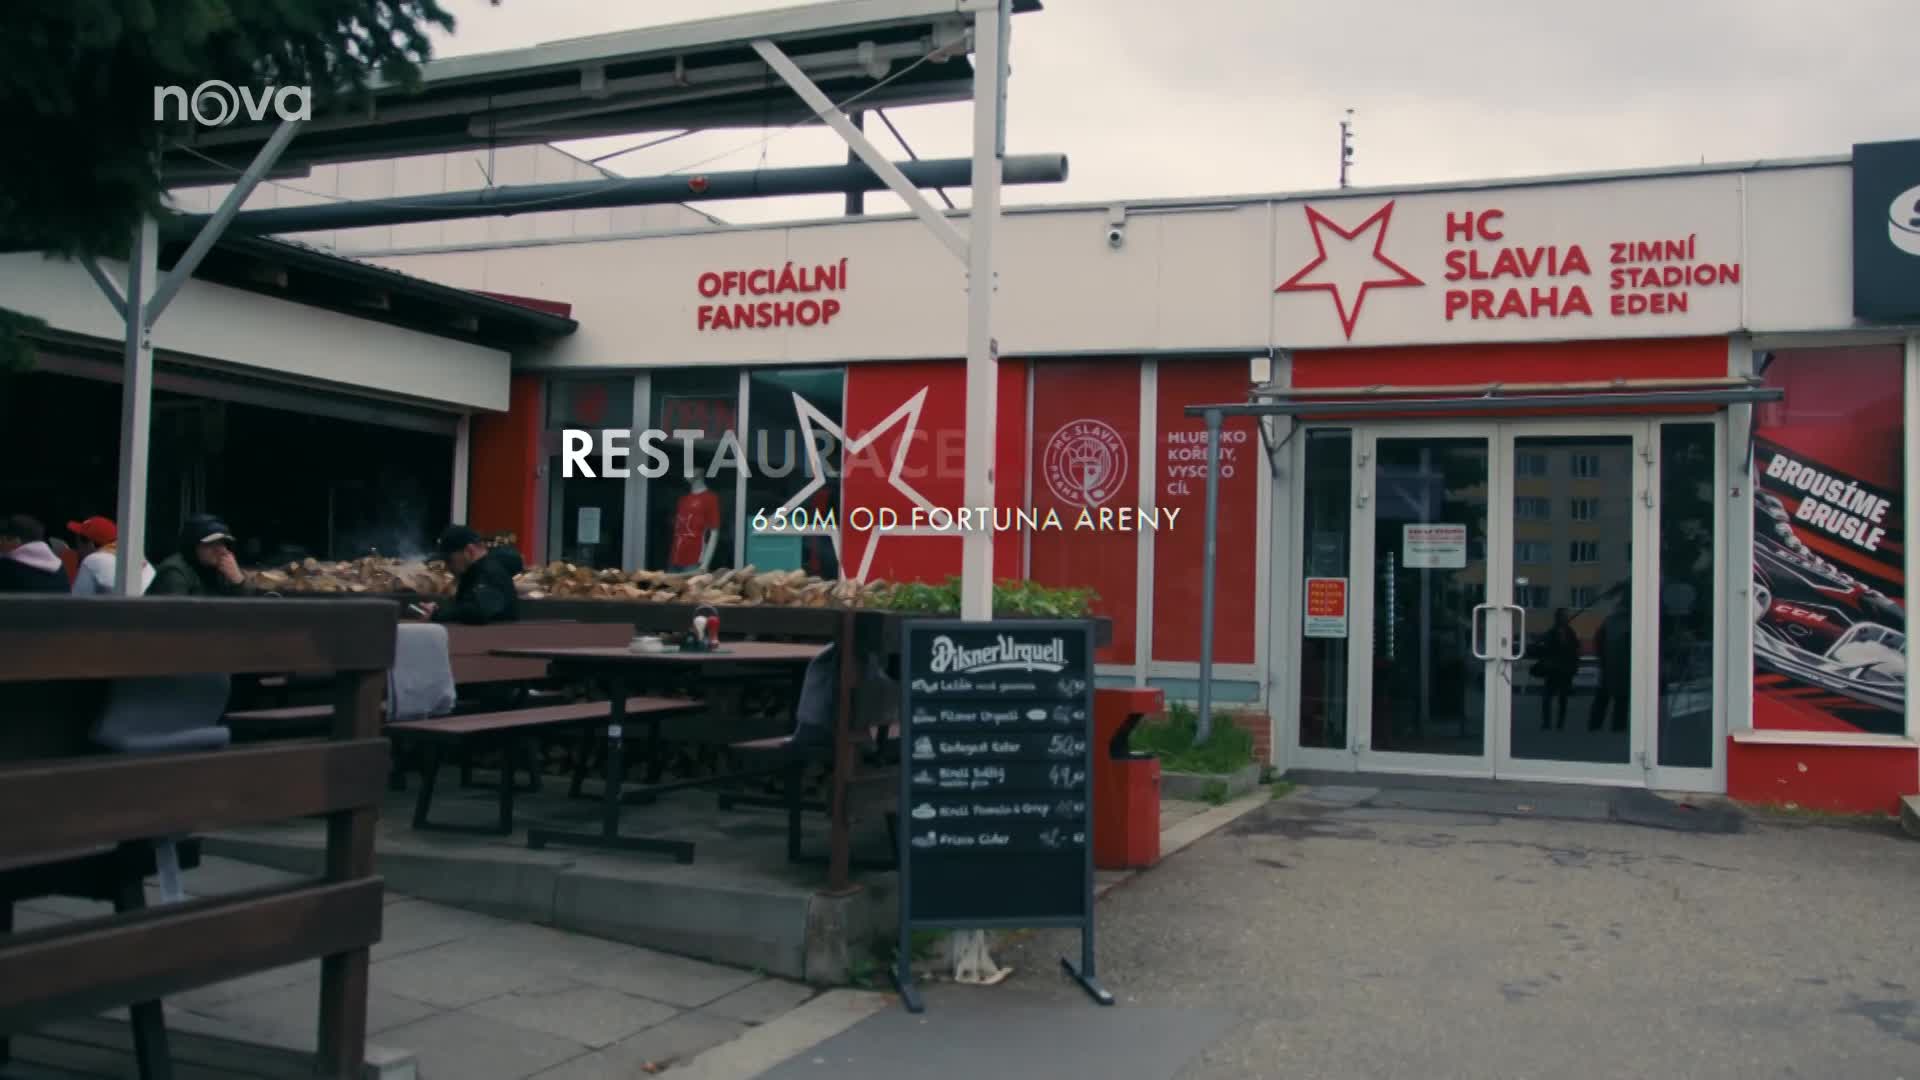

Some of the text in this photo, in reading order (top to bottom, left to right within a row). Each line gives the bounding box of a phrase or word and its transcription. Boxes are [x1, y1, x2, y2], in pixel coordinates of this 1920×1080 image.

[1446, 209, 1504, 242] HC
[1444, 245, 1592, 282] SLAVIA
[1609, 234, 1696, 265] ZIMNÍ
[698, 257, 848, 298] OFICIÁLNÍ
[1610, 263, 1740, 290] STADION
[697, 299, 841, 331] FANSHOP
[1445, 286, 1593, 321] PRAHA
[1610, 292, 1688, 316] EDEN
[1073, 424, 1121, 452] SLAVIA
[1168, 431, 1247, 444] HLUBKO
[1168, 465, 1234, 478] VYSOO
[1167, 479, 1191, 496] CÍL
[1765, 453, 1891, 524] BROUSÍME
[1795, 496, 1886, 552] BRUSLE
[1773, 604, 1828, 623] CCM
[930, 634, 1065, 673] Pilsner Urquell
